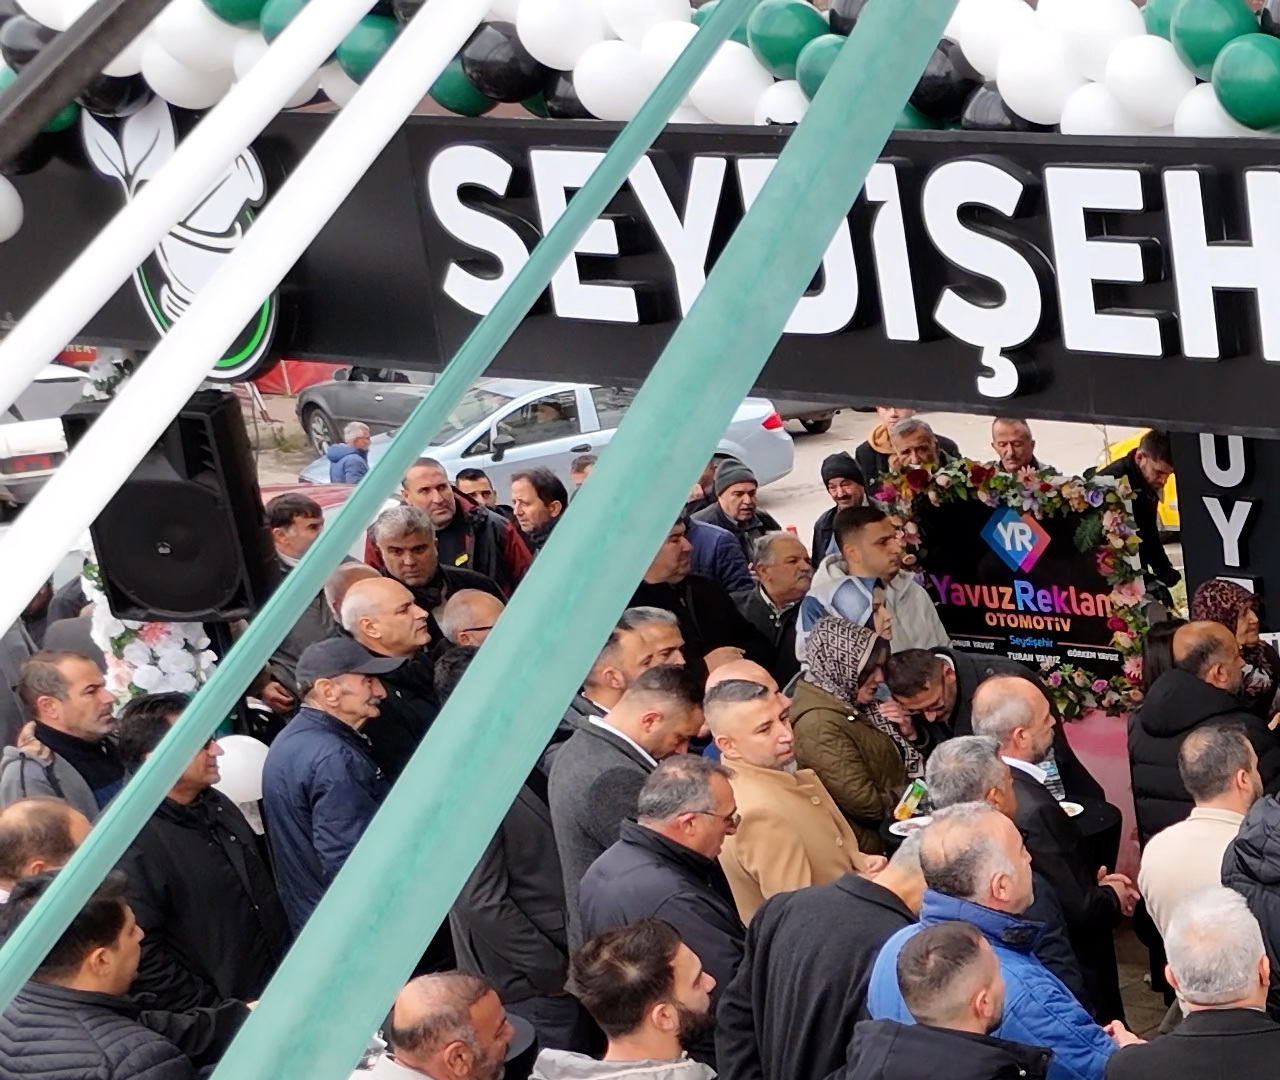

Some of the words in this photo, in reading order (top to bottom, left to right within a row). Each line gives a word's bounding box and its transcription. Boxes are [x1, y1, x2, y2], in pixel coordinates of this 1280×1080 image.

[1199, 433, 1255, 594] UY
[998, 521, 1034, 552] YR
[985, 611, 1071, 632] OTOMOTİV
